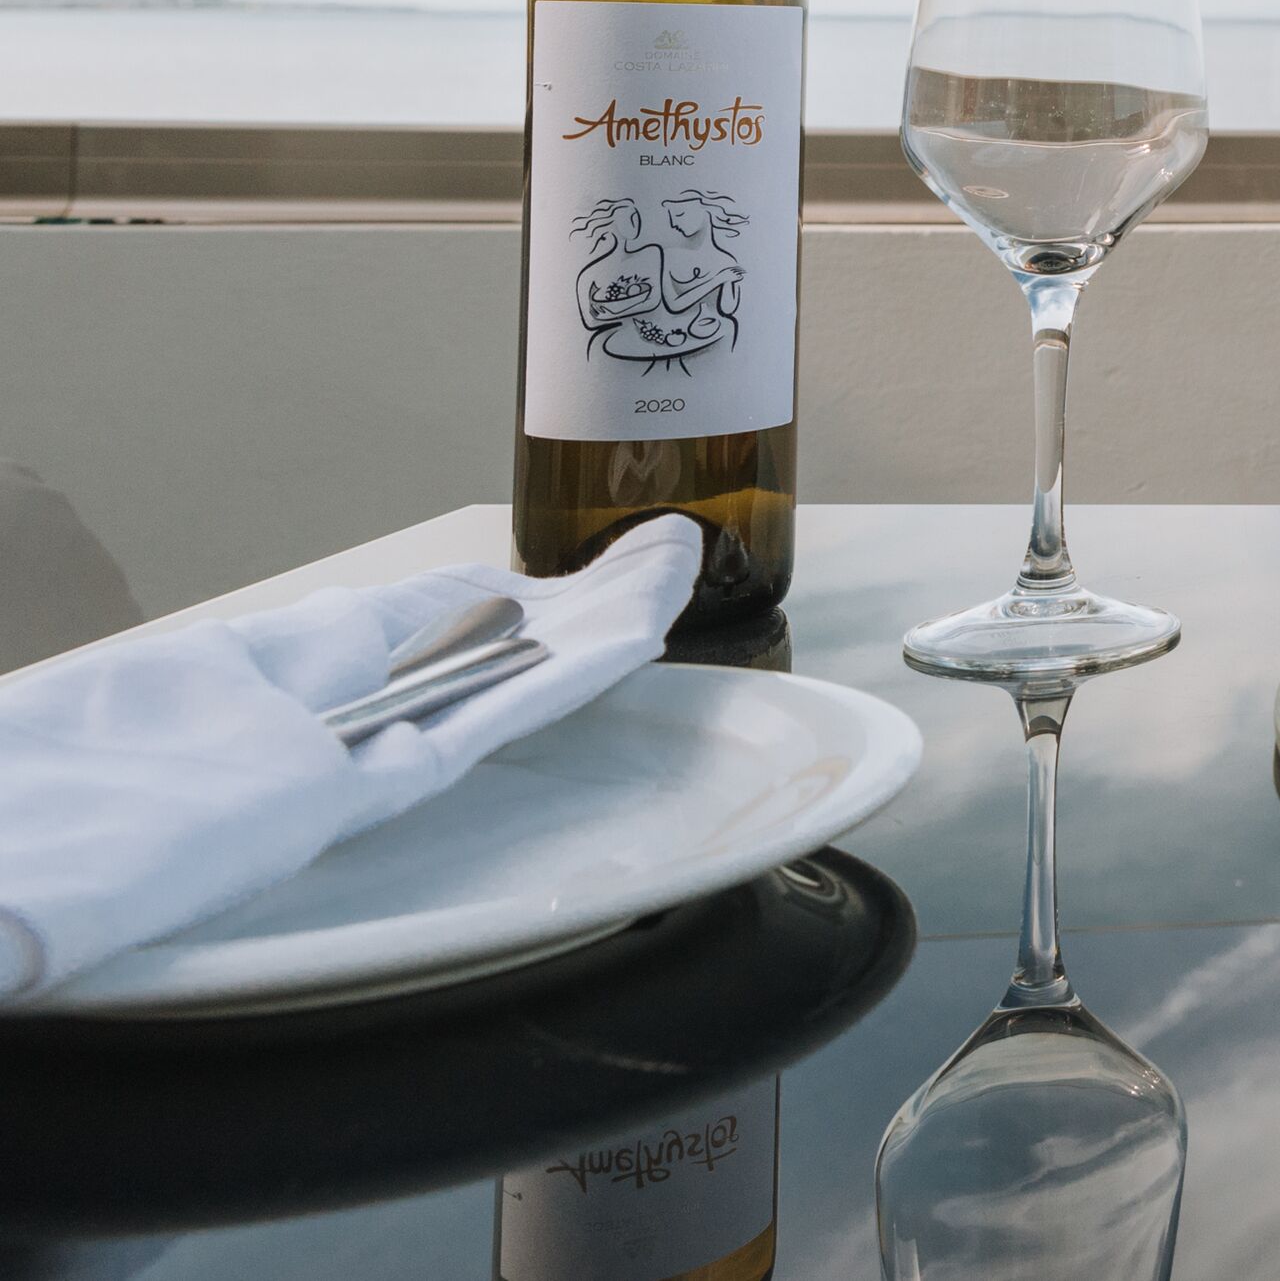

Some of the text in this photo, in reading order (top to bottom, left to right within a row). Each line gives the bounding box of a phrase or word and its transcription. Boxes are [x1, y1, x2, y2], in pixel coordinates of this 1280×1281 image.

[645, 51, 701, 61] DOMAINE
[614, 61, 662, 71] COSTA
[562, 96, 765, 150] Amethystos
[639, 154, 695, 166] BLANC
[634, 397, 686, 413] 2020
